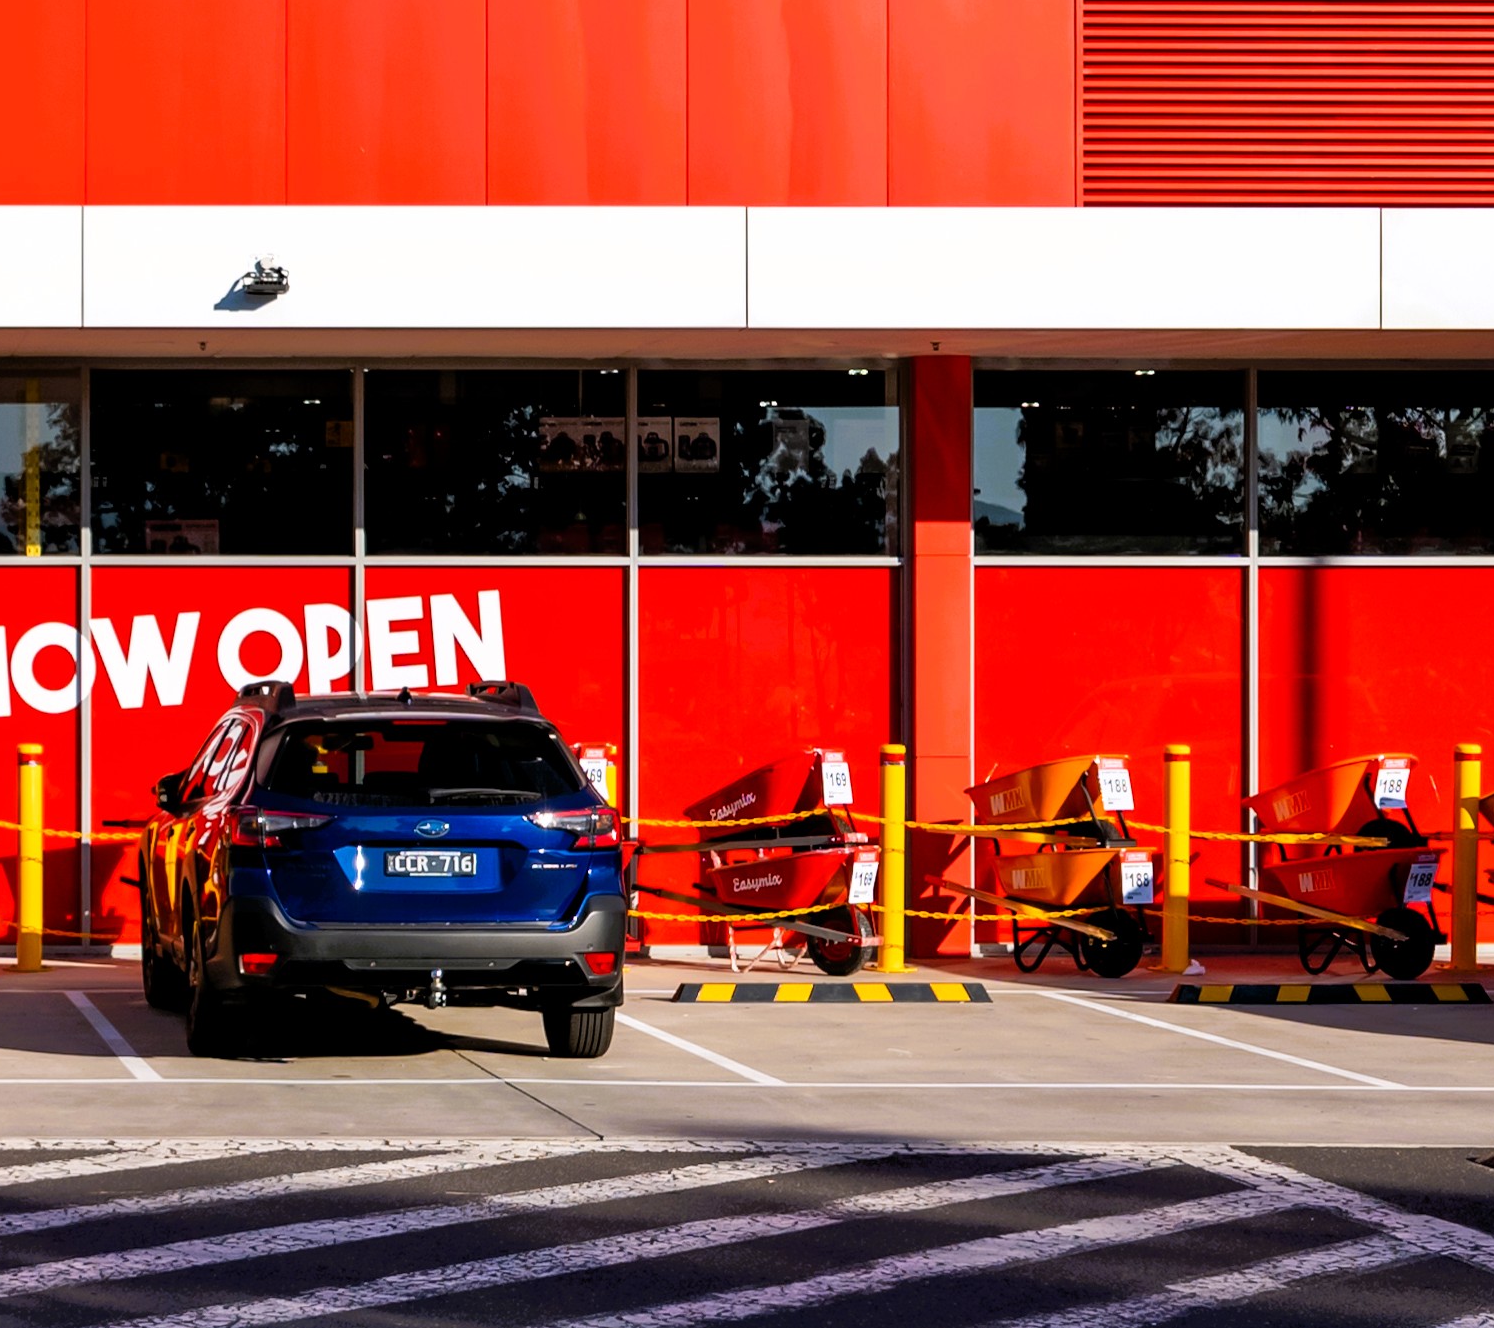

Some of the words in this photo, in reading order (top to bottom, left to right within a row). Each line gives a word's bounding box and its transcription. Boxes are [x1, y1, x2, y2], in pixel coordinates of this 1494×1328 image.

[216, 589, 507, 696] OPEN
[710, 792, 756, 822] Easymix
[733, 873, 783, 893] Easymix
